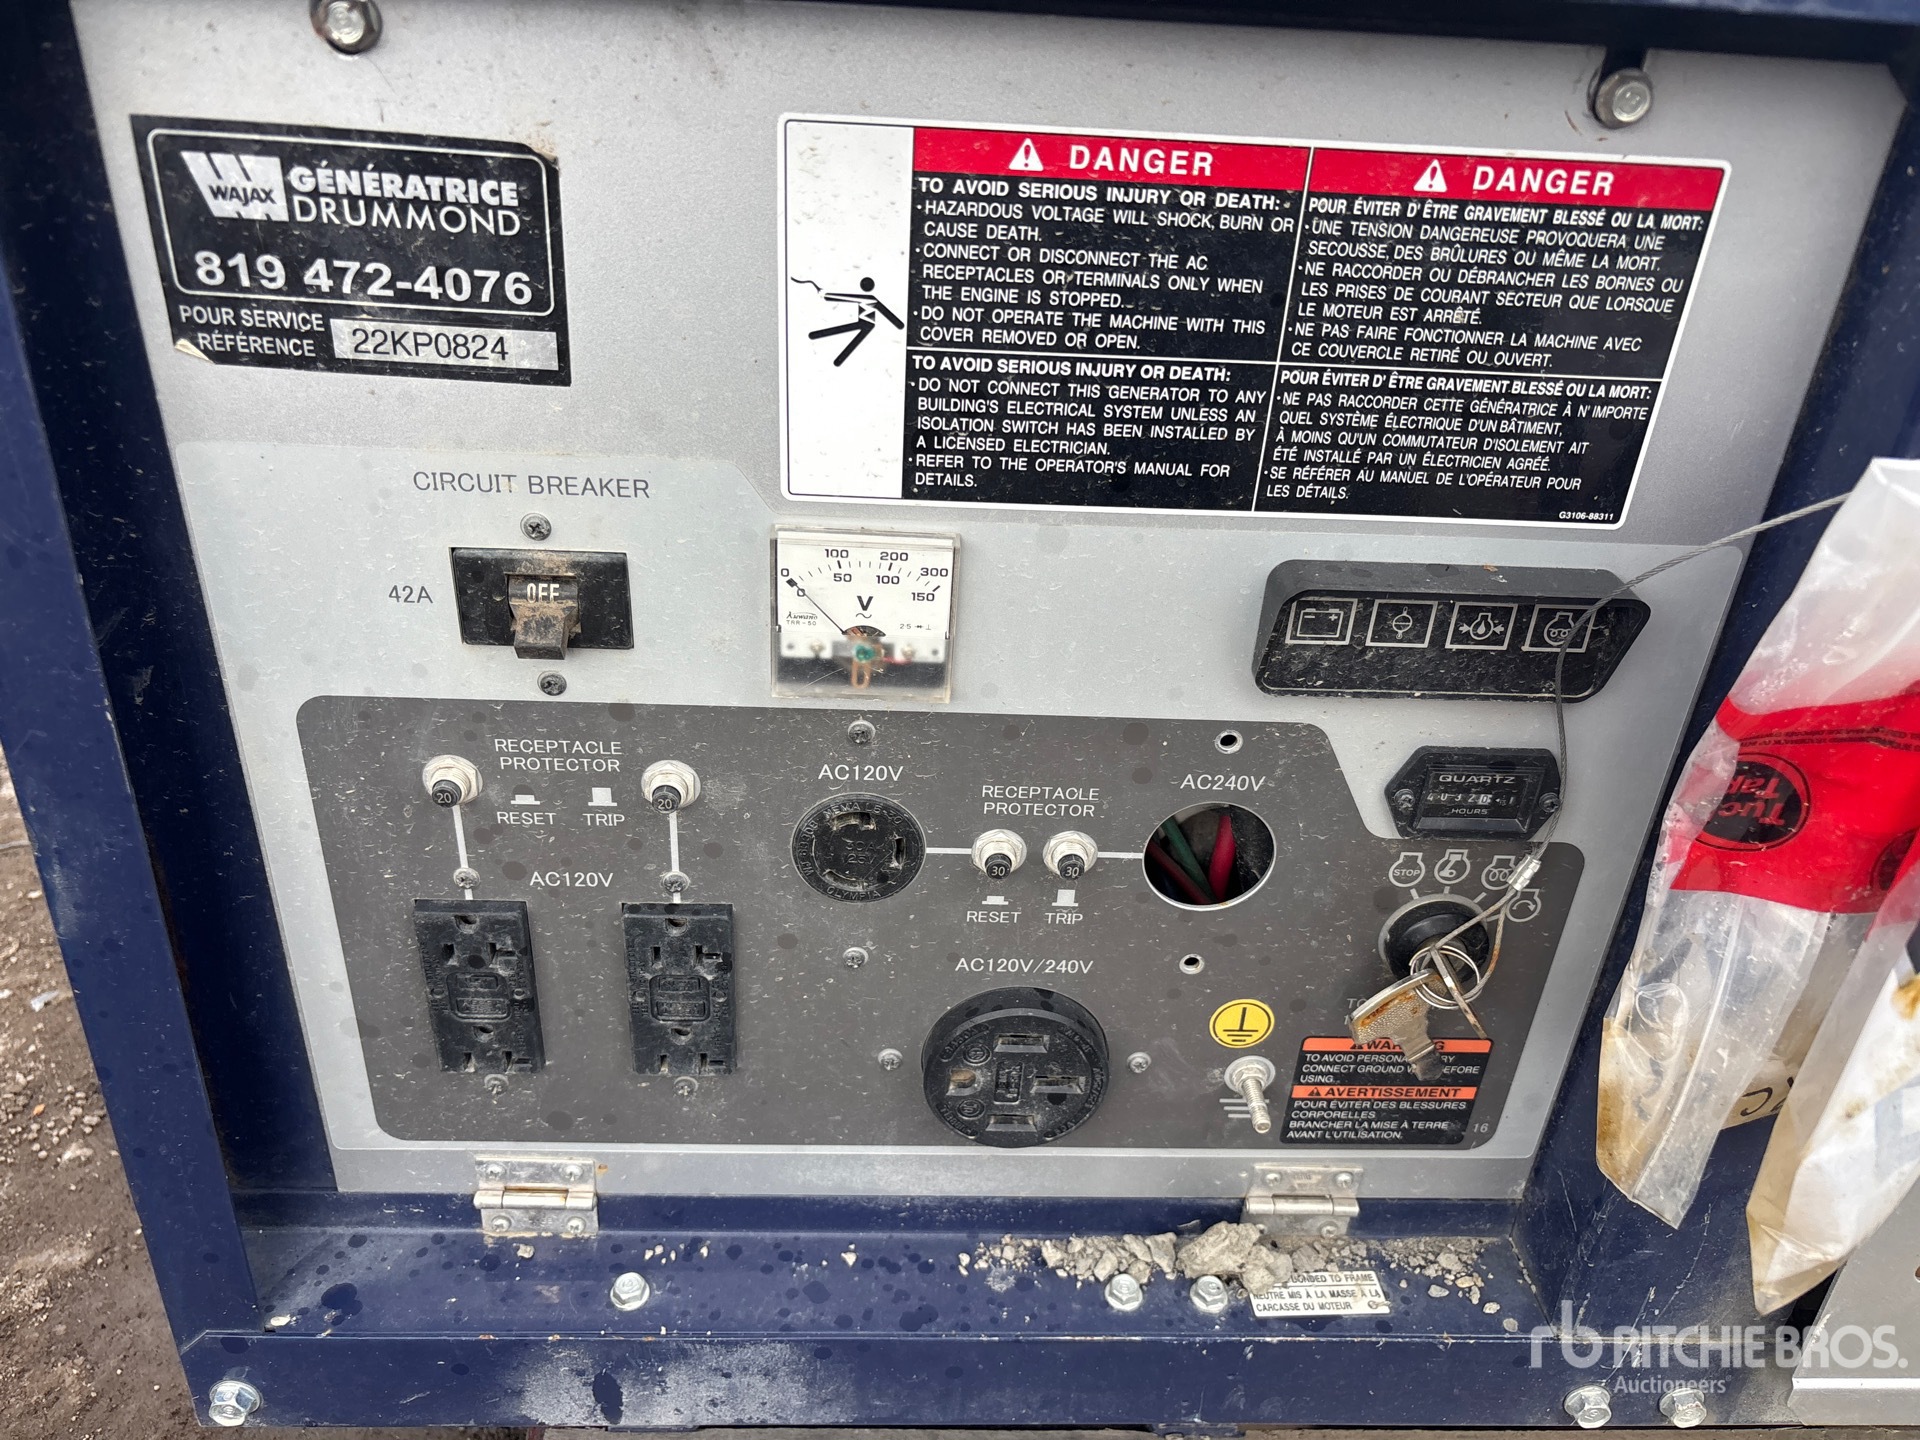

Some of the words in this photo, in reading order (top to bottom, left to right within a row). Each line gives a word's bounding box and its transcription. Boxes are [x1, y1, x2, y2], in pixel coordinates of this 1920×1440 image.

[1069, 144, 1212, 176] DANGER
[288, 162, 519, 206] GÉNÉRATRICE
[1472, 165, 1614, 195] DANGER
[208, 184, 276, 205] WAJAX
[918, 176, 943, 193] TO
[952, 178, 1009, 196] AVOID
[1018, 181, 1097, 201] SERIOUS
[1106, 186, 1171, 204] INJURY
[1179, 190, 1206, 207] OR
[1215, 192, 1280, 210] DEATH:
[294, 194, 520, 236] DRUMMOND
[924, 200, 1022, 219] HAZARDOUS
[1031, 204, 1104, 222] VOLTAGE
[1112, 209, 1148, 225] WILL
[1157, 210, 1214, 230] SHOCK,
[1219, 214, 1263, 230] BURN
[1270, 216, 1294, 232] OR
[924, 220, 977, 238] CAUSE
[986, 224, 1041, 241] DEATH.
[1311, 218, 1342, 235] UNE
[1350, 220, 1413, 238] TENSION
[1419, 224, 1520, 243] DANGEREUSE
[1525, 229, 1626, 248] PROVOQUERA
[1634, 234, 1665, 250] UNE
[923, 242, 1000, 260] CONNECT
[1007, 246, 1030, 262] OR
[1039, 248, 1140, 266] DISCONNECT
[1149, 252, 1178, 268] THE
[1185, 255, 1207, 270] AC
[1307, 240, 1389, 260] SECOUSSE,
[1393, 244, 1423, 260] DES
[1430, 244, 1507, 264] BRÛLURES
[1512, 248, 1536, 265] OU
[1542, 249, 1586, 267] MÊME
[1591, 254, 1608, 268] LA
[1615, 255, 1660, 270] MORT.
[194, 251, 286, 289] 819
[304, 257, 532, 305] 472-4076
[922, 263, 1034, 283] RECEPTACLES
[1042, 269, 1065, 284] OR
[1075, 270, 1159, 289] TERMINALS
[1167, 274, 1209, 290] ONLY
[1217, 277, 1263, 293] WHEN
[922, 284, 952, 300] THE
[960, 286, 1018, 303] ENGINE
[1026, 289, 1040, 304] IS
[1049, 290, 1124, 308] STOPPED.
[179, 305, 235, 326] POUR
[241, 308, 325, 331] SERVICE
[921, 305, 944, 320] DO
[952, 306, 984, 322] NOT
[991, 308, 1064, 326] OPERATE
[1071, 312, 1101, 327] THE
[1109, 313, 1178, 330] MACHINE
[1186, 317, 1224, 332] WITH
[1232, 318, 1265, 334] THIS
[199, 329, 315, 357] RÉFÉRENCE
[352, 328, 508, 360] 22KP0824
[920, 325, 973, 342] COVER
[981, 328, 1056, 345] REMOVED
[1064, 332, 1087, 348] OR
[1094, 333, 1139, 348] OPEN.
[918, 377, 940, 391] DO
[948, 378, 980, 393] NOT
[987, 380, 1060, 396] CONNECT
[1067, 383, 1100, 398] THIS
[1105, 384, 1200, 401] GENERATOR
[1208, 388, 1228, 402] TO
[1234, 389, 1266, 403] ANY
[917, 416, 993, 432] ISOLATION
[1001, 419, 1058, 434] SWITCH
[1066, 422, 1095, 436] HAS
[1103, 423, 1142, 437] BEEN
[1150, 425, 1227, 440] INSTALLED
[1235, 427, 1255, 440] BY
[413, 472, 517, 493] CIRCUIT
[528, 475, 650, 498] BREAKER
[1558, 510, 1613, 520] G3106-88311
[781, 569, 789, 577] 0
[824, 549, 849, 558] 100
[880, 552, 908, 561] 200
[920, 568, 948, 577] 300
[388, 585, 433, 604] 42A
[527, 583, 560, 603] OFF
[833, 573, 852, 582] 50
[876, 575, 899, 584] 100
[912, 592, 935, 601] 150
[857, 596, 873, 611] V
[495, 739, 622, 755] RECEPTACLE
[500, 758, 620, 772] PROTECTOR
[818, 764, 903, 782] AC120V
[1180, 775, 1266, 792] AC240V
[1439, 775, 1515, 783] QUARTZ
[437, 793, 451, 803] 20
[982, 785, 1099, 801] RECEPTACLE
[658, 799, 673, 810] 20
[983, 802, 1095, 817] PROTECTOR
[497, 812, 557, 825] RESET
[583, 813, 625, 826] TRIP
[1716, 801, 1785, 826] Tuc
[530, 872, 613, 887] AC120V
[991, 866, 1005, 877] 30
[1066, 866, 1079, 877] 30
[1394, 869, 1420, 877] STOP
[966, 911, 1022, 924] RESET
[1045, 913, 1083, 925] TRIP
[955, 958, 1094, 974] AC120V/240V
[1305, 1054, 1319, 1062] TO
[1322, 1054, 1354, 1062] AVOID
[1356, 1054, 1410, 1063] PERSONA
[1302, 1065, 1353, 1073] CONNECT
[1357, 1065, 1404, 1074] GROUND
[1443, 1065, 1480, 1074] EFORE
[1325, 1088, 1461, 1098] AVERTISSEMENT
[1294, 1101, 1327, 1109] POUR
[1330, 1099, 1372, 1109] ÉVITER
[1374, 1101, 1397, 1109] DES
[1400, 1101, 1466, 1109] BLESSURES
[1291, 1111, 1375, 1119] CORPORELLES
[1289, 1121, 1352, 1129] BRANCHER
[1354, 1121, 1369, 1129] LA
[1370, 1121, 1398, 1129] MISE
[1412, 1121, 1448, 1129] TERRE
[1473, 1123, 1488, 1133] 16
[1286, 1130, 1323, 1138] AVANT
[1329, 1274, 1341, 1282] TO
[1345, 1274, 1374, 1282] FRAME
[1288, 1290, 1302, 1298] MIS
[1314, 1290, 1326, 1298] LA
[1329, 1290, 1356, 1298] MASSE
[1256, 1303, 1300, 1311] CARCASSE
[1303, 1302, 1315, 1311] DU
[1318, 1302, 1352, 1310] MOTEUR
